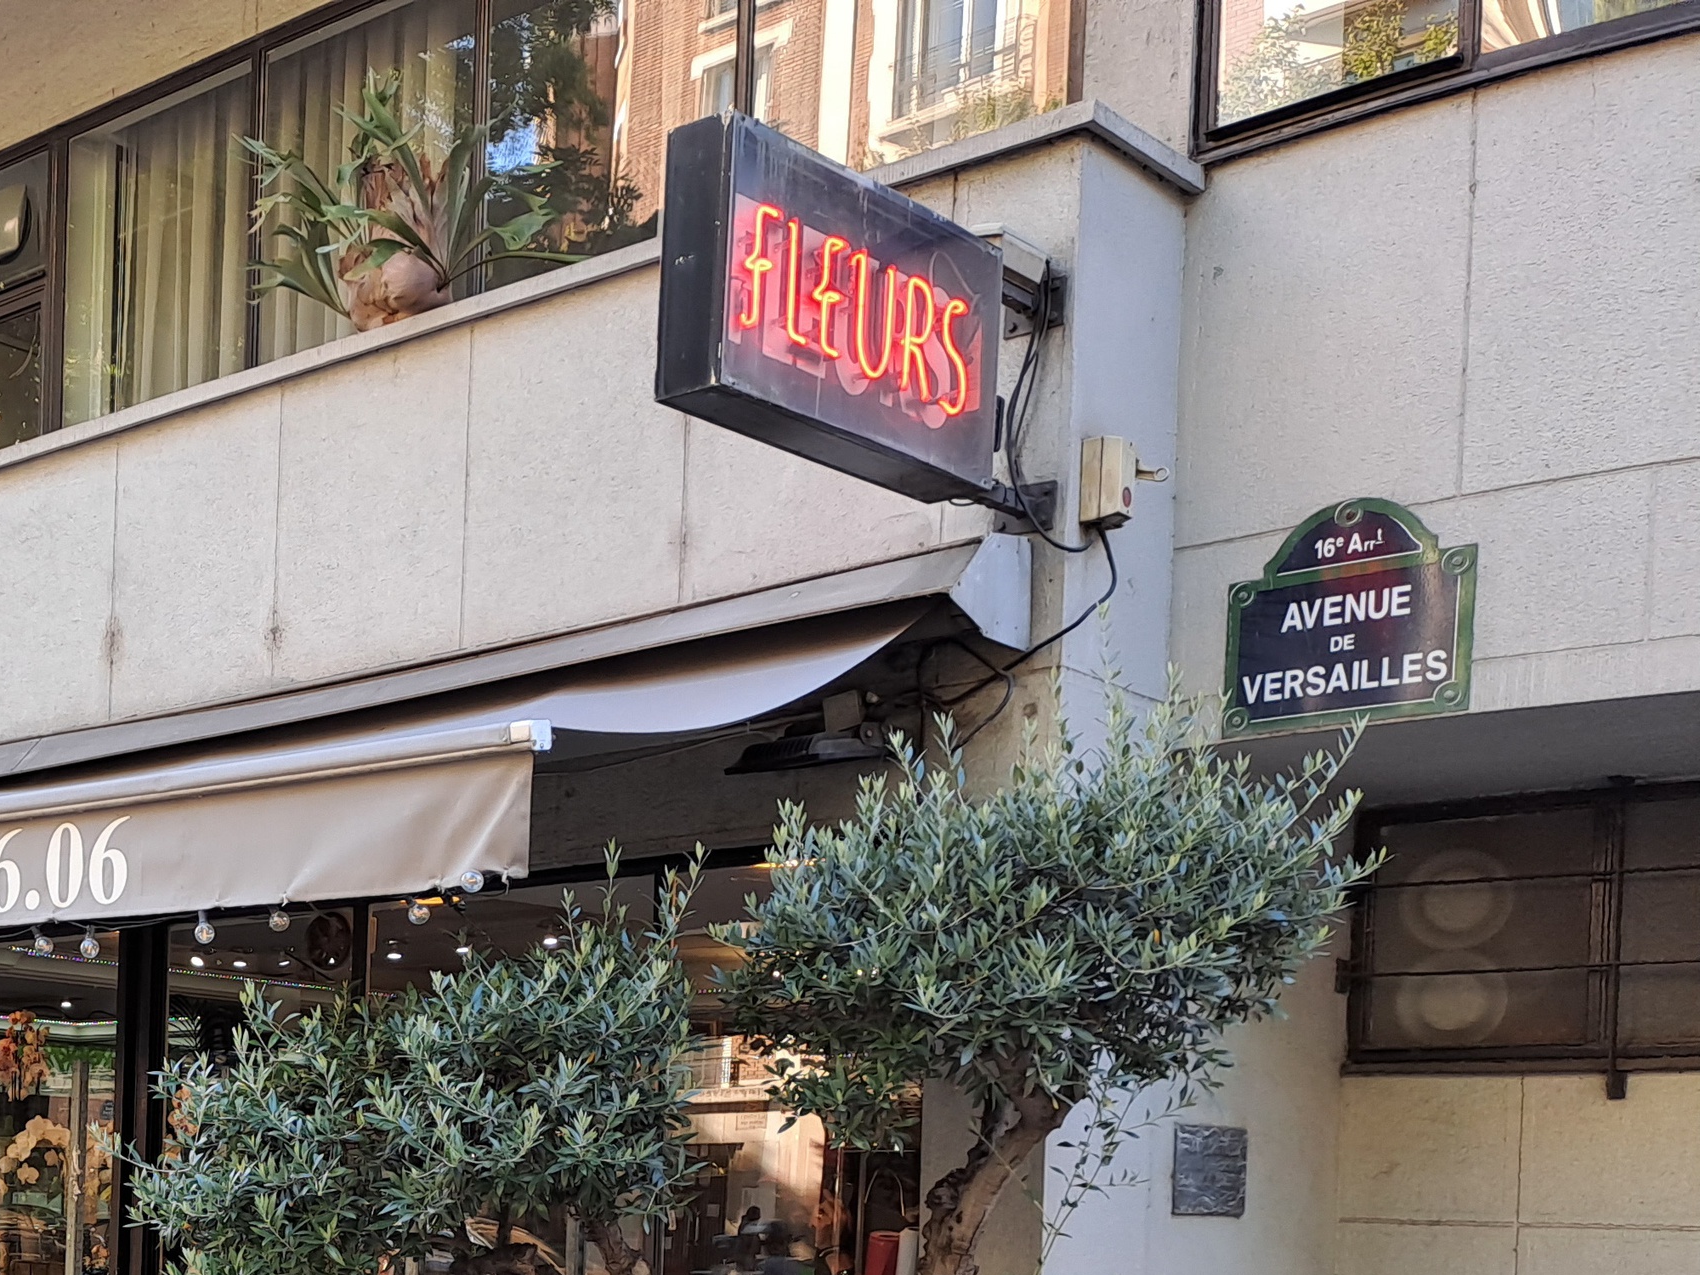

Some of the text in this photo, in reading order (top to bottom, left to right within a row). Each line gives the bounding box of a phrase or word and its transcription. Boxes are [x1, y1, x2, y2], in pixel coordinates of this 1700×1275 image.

[740, 203, 969, 418] FLEURS
[1314, 535, 1344, 559] 16e
[1280, 584, 1412, 633] AVENUE
[1330, 634, 1355, 653] DE
[1241, 649, 1448, 704] VERSAILLES
